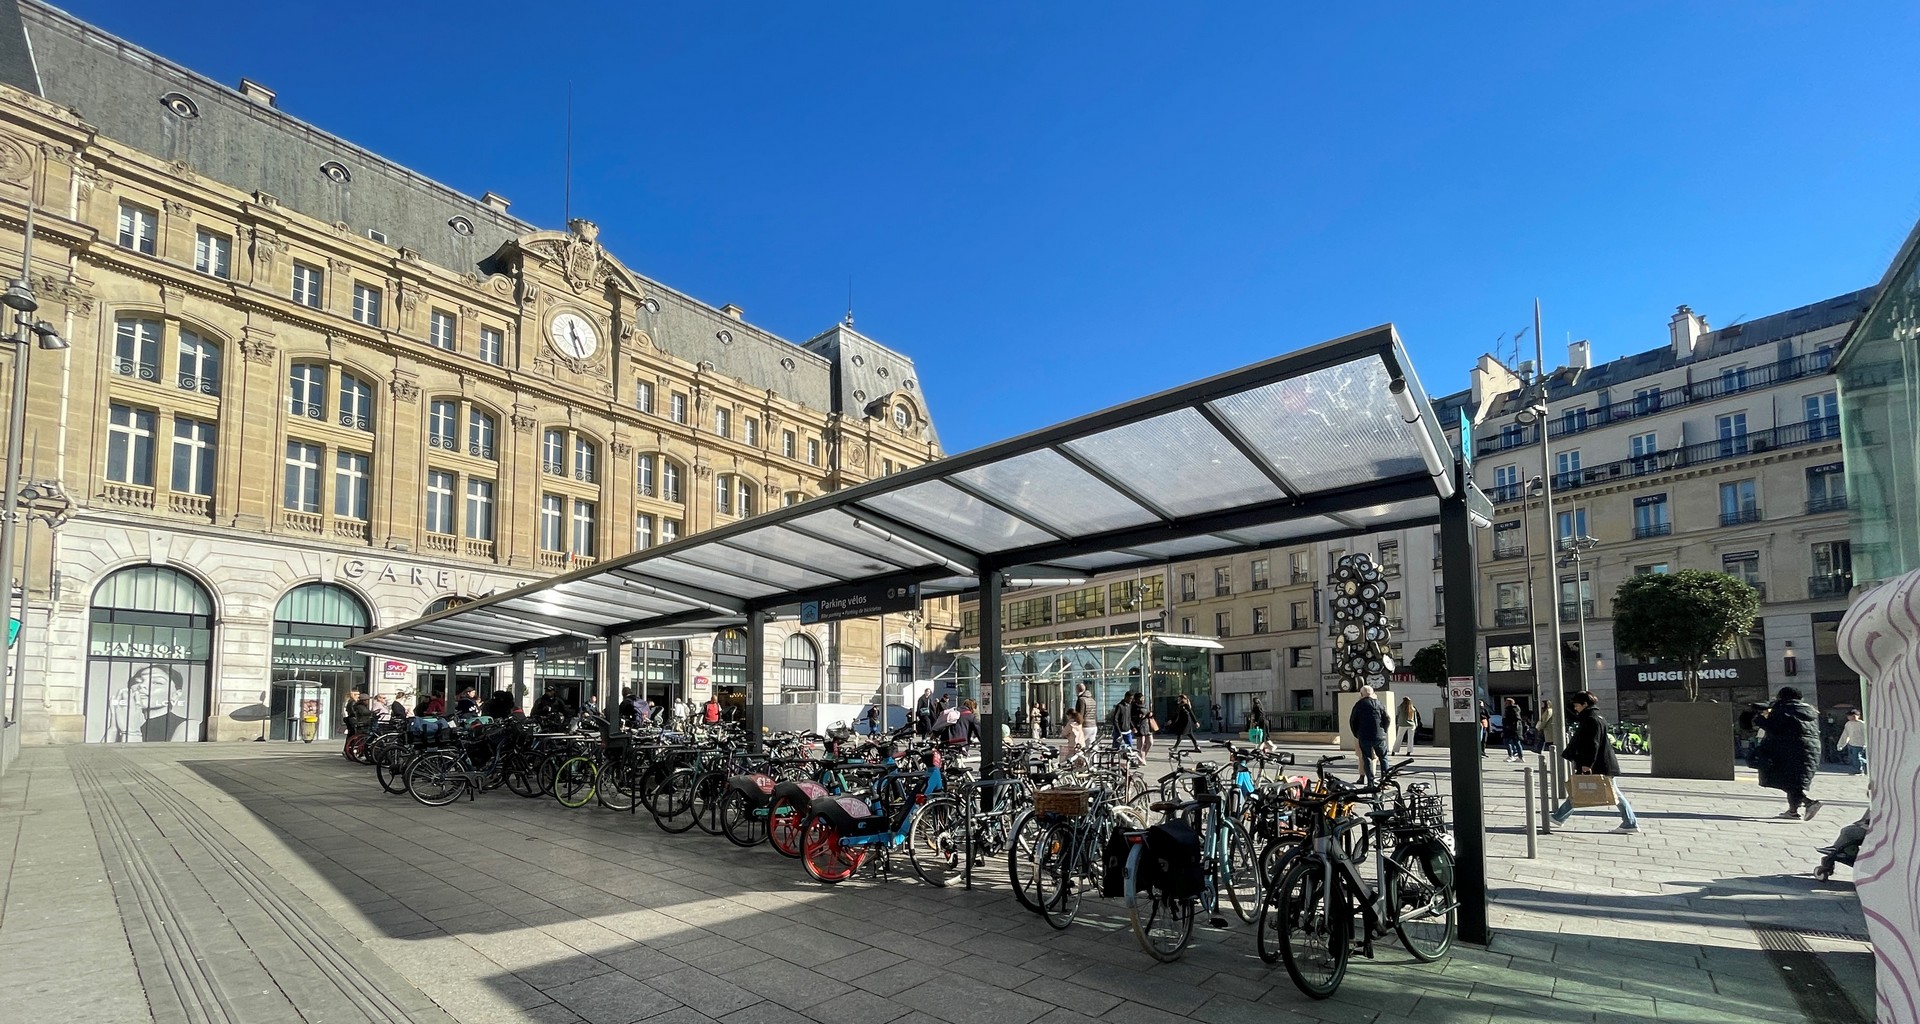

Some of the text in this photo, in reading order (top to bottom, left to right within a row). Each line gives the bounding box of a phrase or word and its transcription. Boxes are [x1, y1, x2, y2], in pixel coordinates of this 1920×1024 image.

[343, 560, 449, 589] GARE
[821, 595, 867, 610] Parking vélos
[104, 641, 192, 656] PANDORA
[280, 651, 352, 664] PANDORA
[1697, 668, 1738, 680] KING
